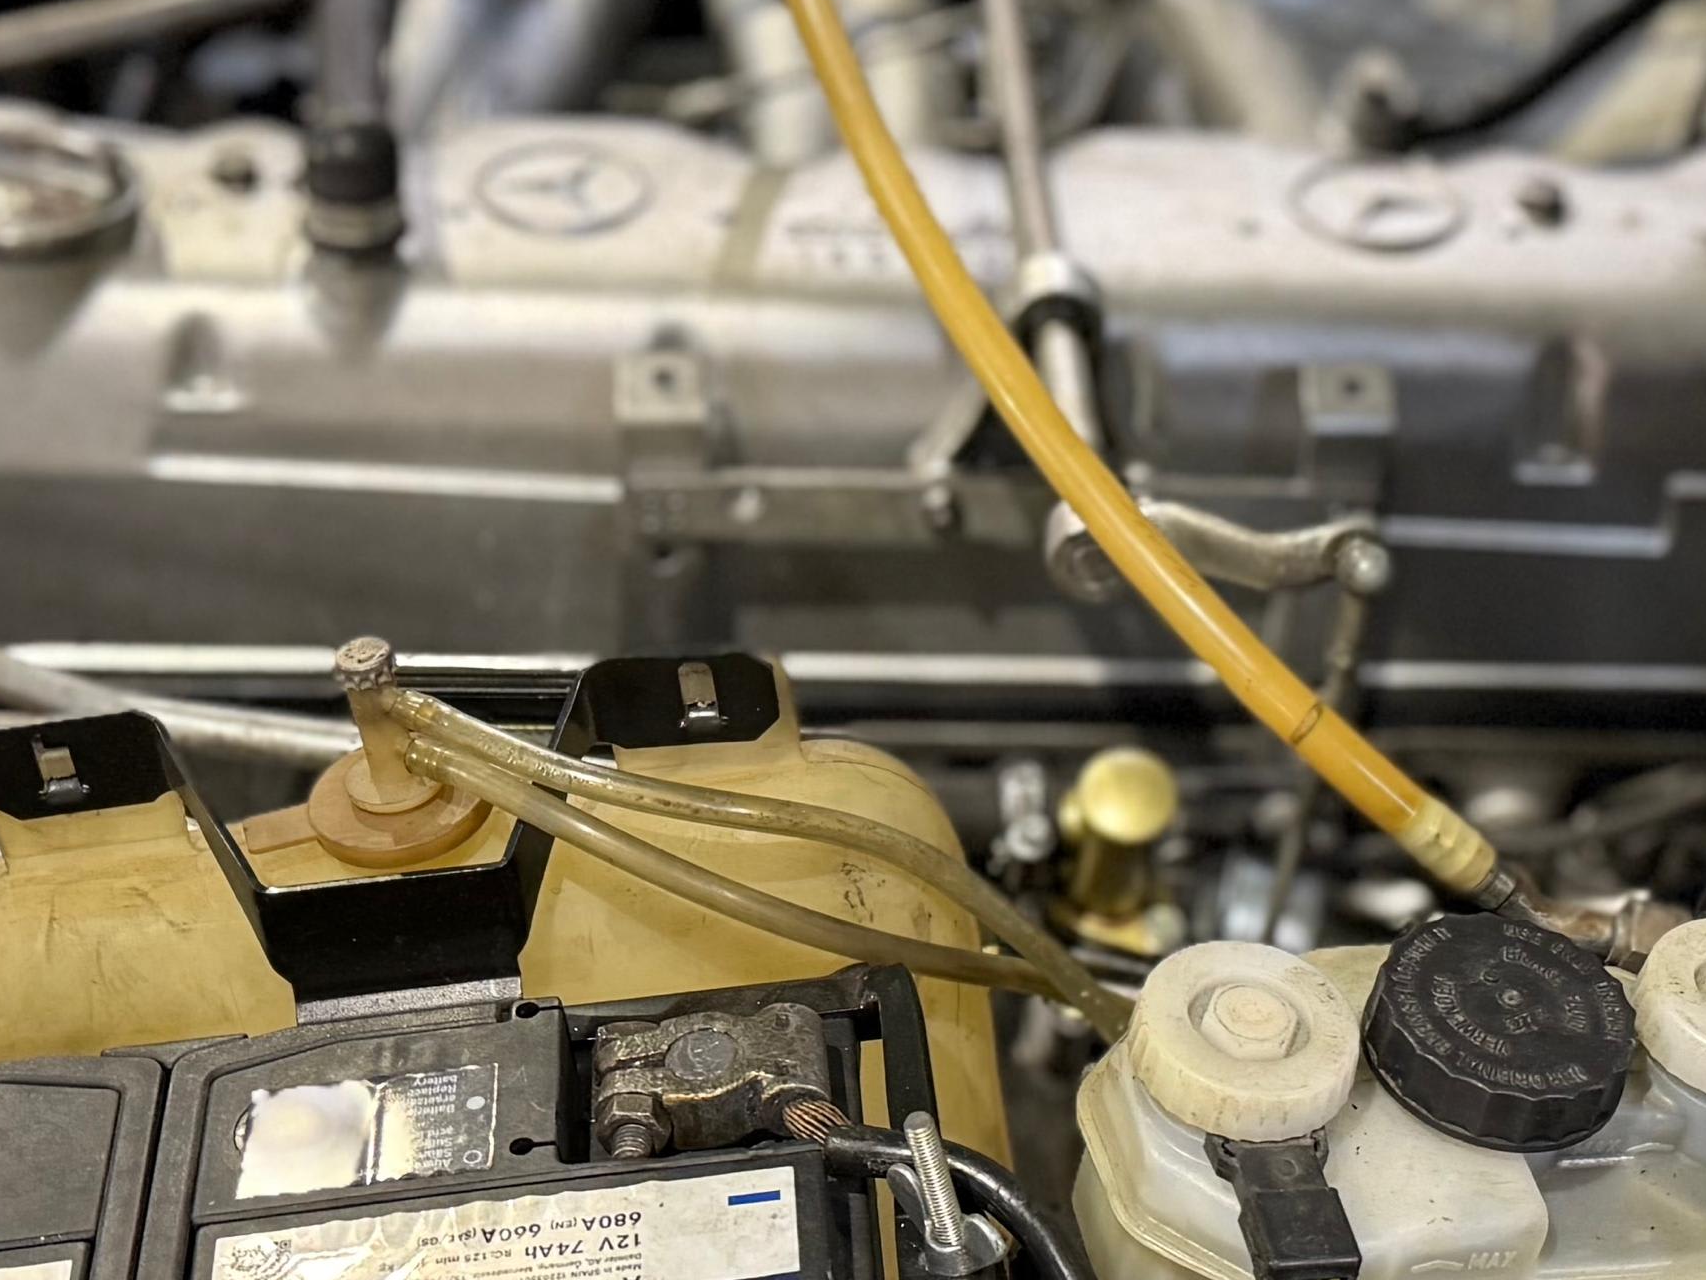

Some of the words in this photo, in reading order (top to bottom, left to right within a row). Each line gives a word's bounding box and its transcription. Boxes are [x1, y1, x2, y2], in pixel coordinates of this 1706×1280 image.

[550, 1216, 576, 1230] (EN)
[581, 1210, 641, 1231] 680A
[480, 1220, 540, 1243] 660A
[598, 1232, 641, 1251] 12V
[524, 1239, 583, 1260] 74Ah
[1467, 1250, 1518, 1271] MAX
[570, 1268, 600, 1278] SPAIN
